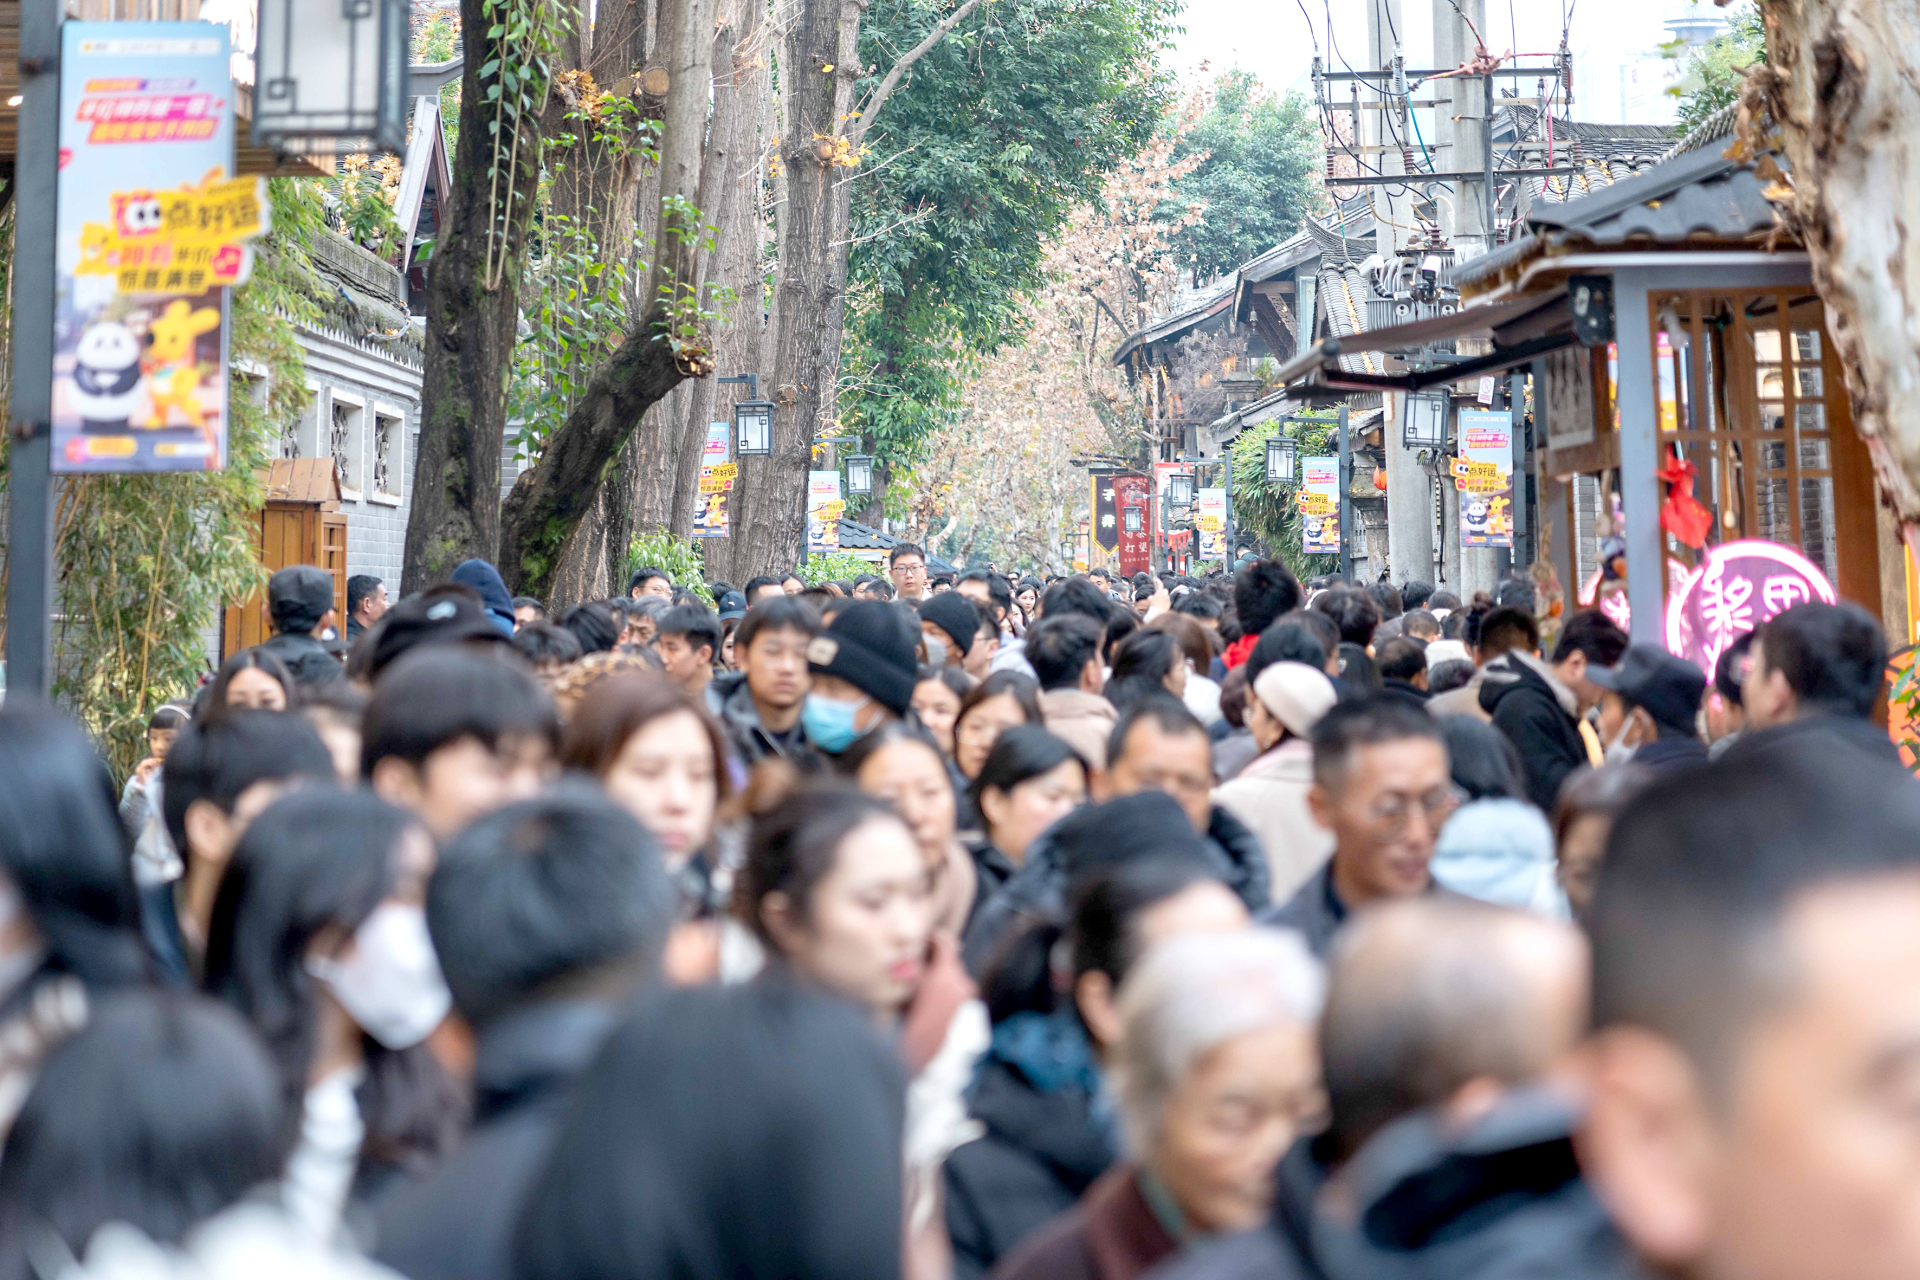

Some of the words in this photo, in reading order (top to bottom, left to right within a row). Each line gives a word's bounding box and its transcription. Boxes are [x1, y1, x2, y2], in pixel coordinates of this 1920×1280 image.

[712, 467, 737, 478] 点好运
[1469, 467, 1496, 477] 点好运
[1308, 496, 1328, 504] 点好运
[1124, 541, 1148, 553] 打望
